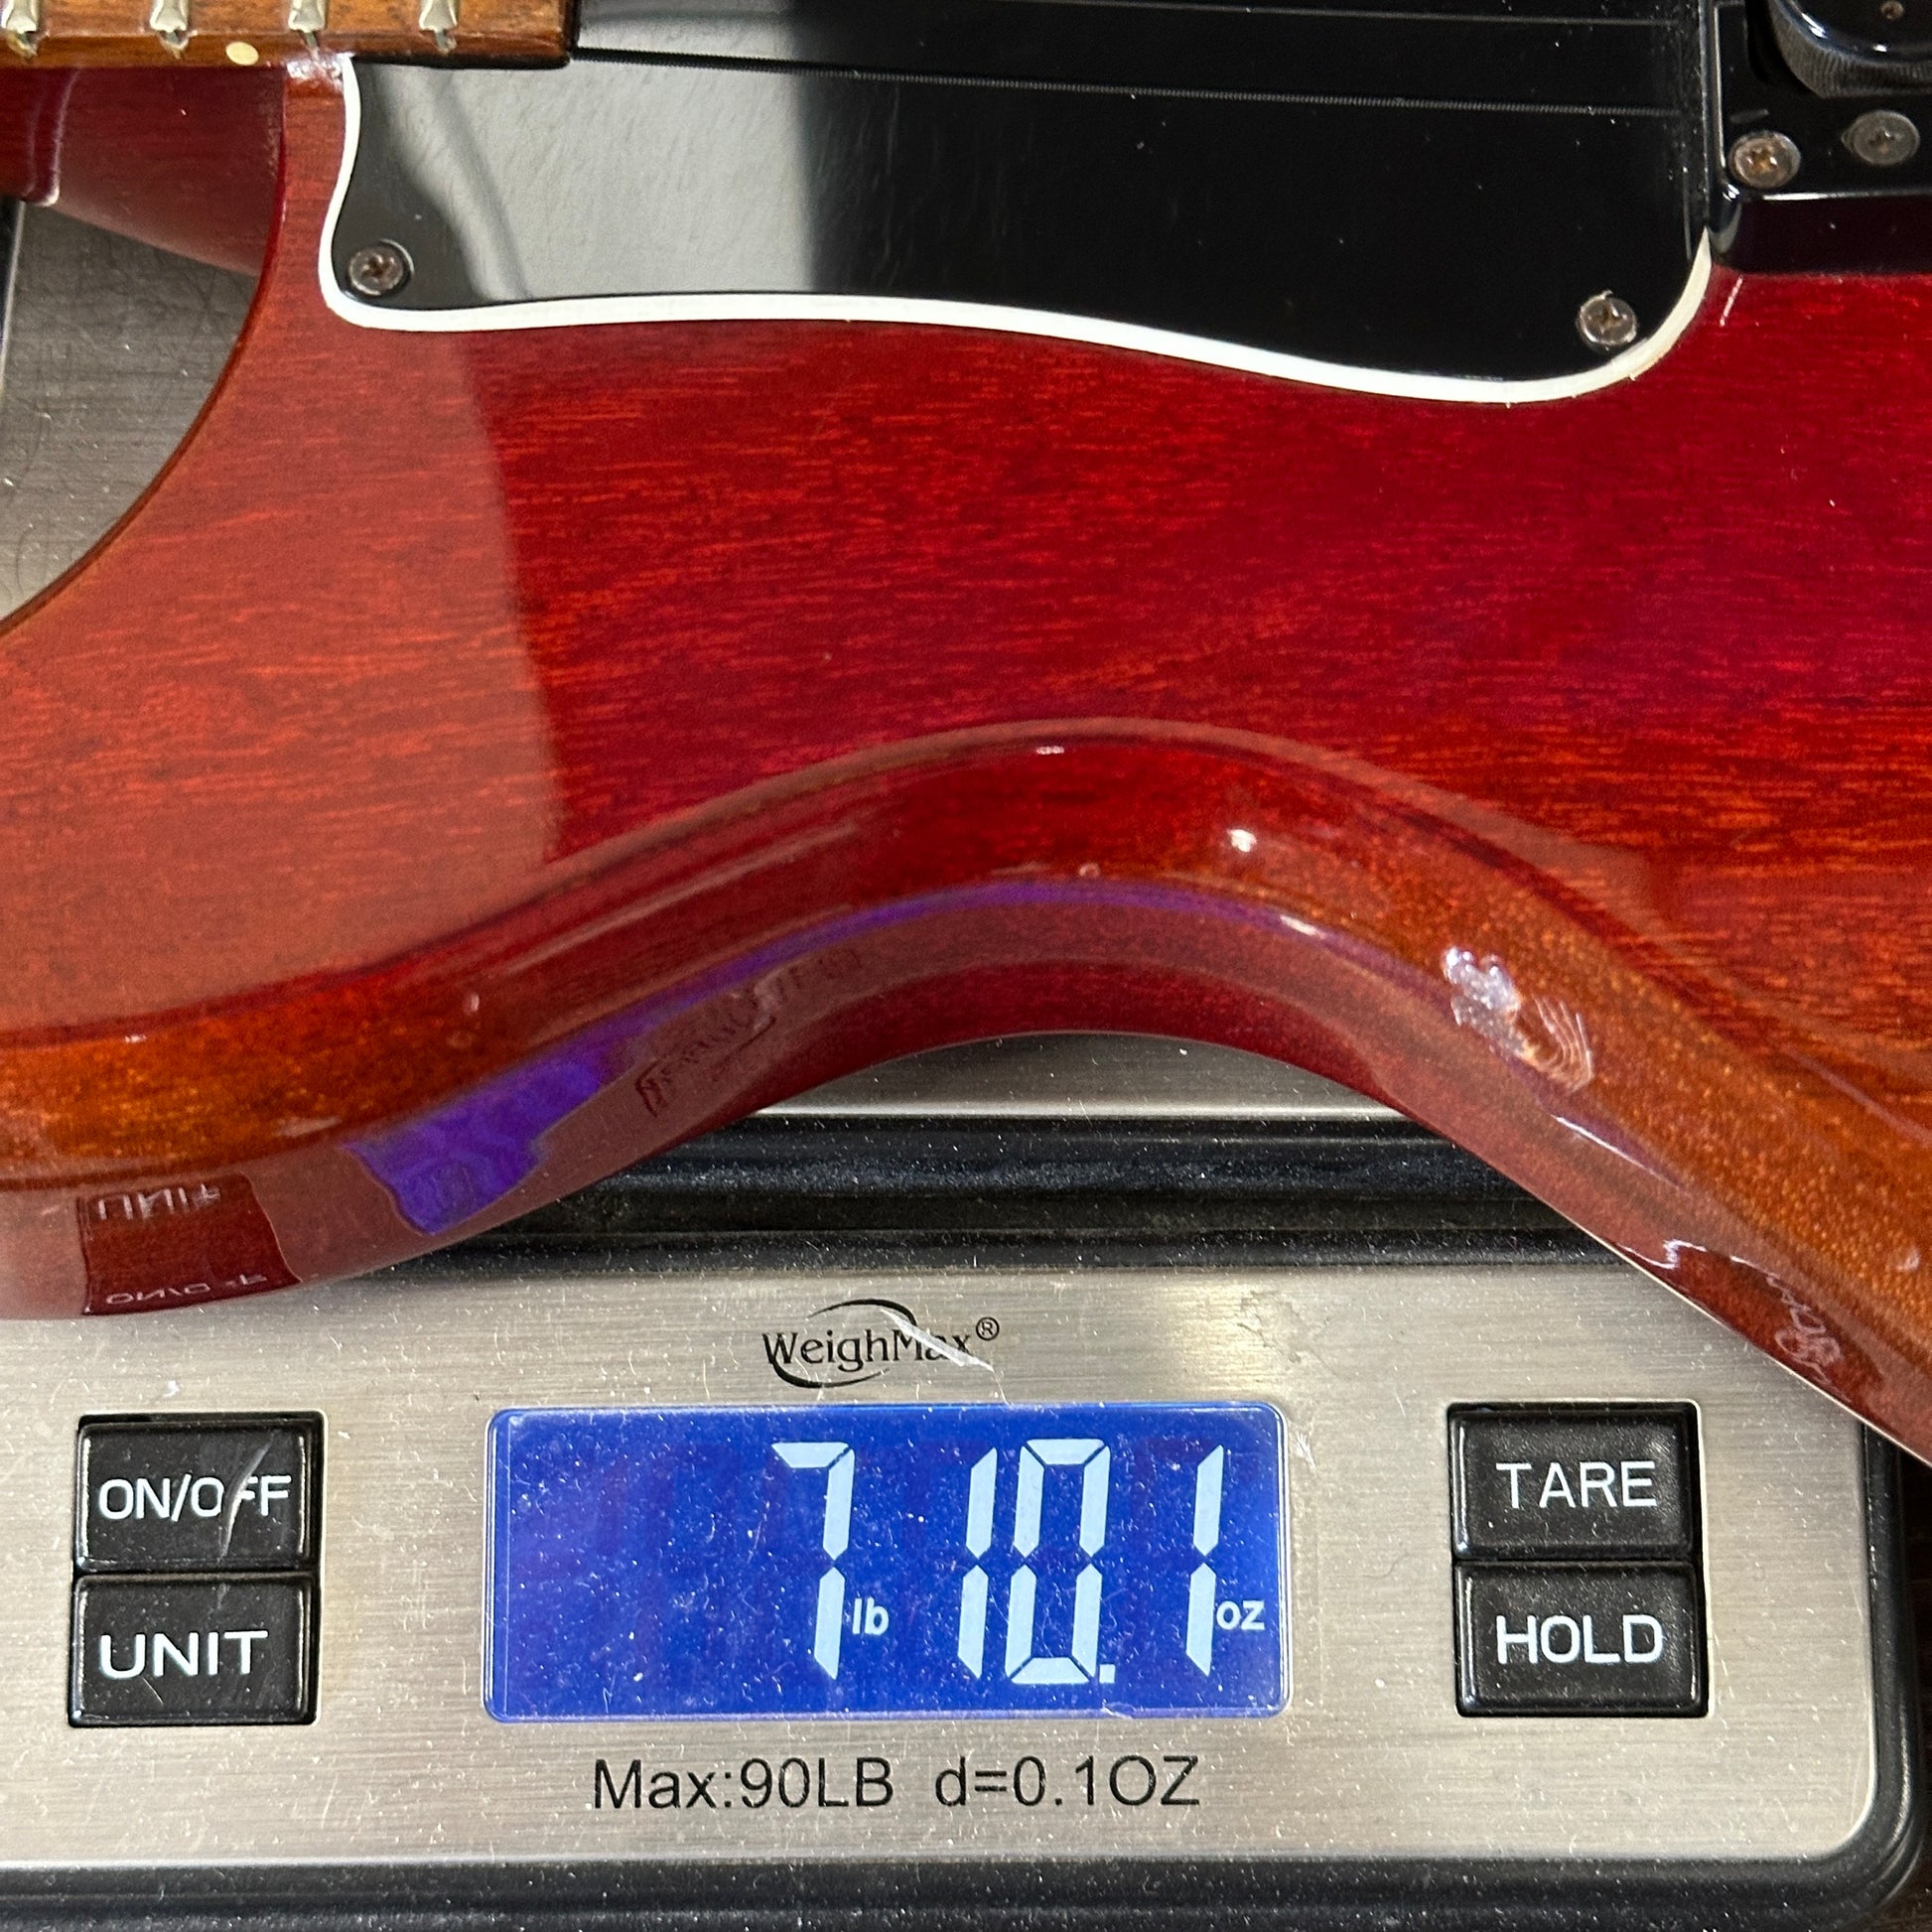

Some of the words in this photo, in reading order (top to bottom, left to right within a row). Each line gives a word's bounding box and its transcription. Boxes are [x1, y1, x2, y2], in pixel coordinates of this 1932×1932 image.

[1495, 1461, 1657, 1509] TARE
[770, 1442, 857, 1680] 7
[851, 1596, 890, 1636] lb
[956, 1438, 1224, 1685] 10.1
[1215, 1600, 1266, 1632] oz
[99, 1630, 269, 1679] UNIT
[1495, 1614, 1664, 1664] HOLD
[594, 1757, 894, 1810] Max:90LB
[934, 1755, 1201, 1809] d=0.1OZ
